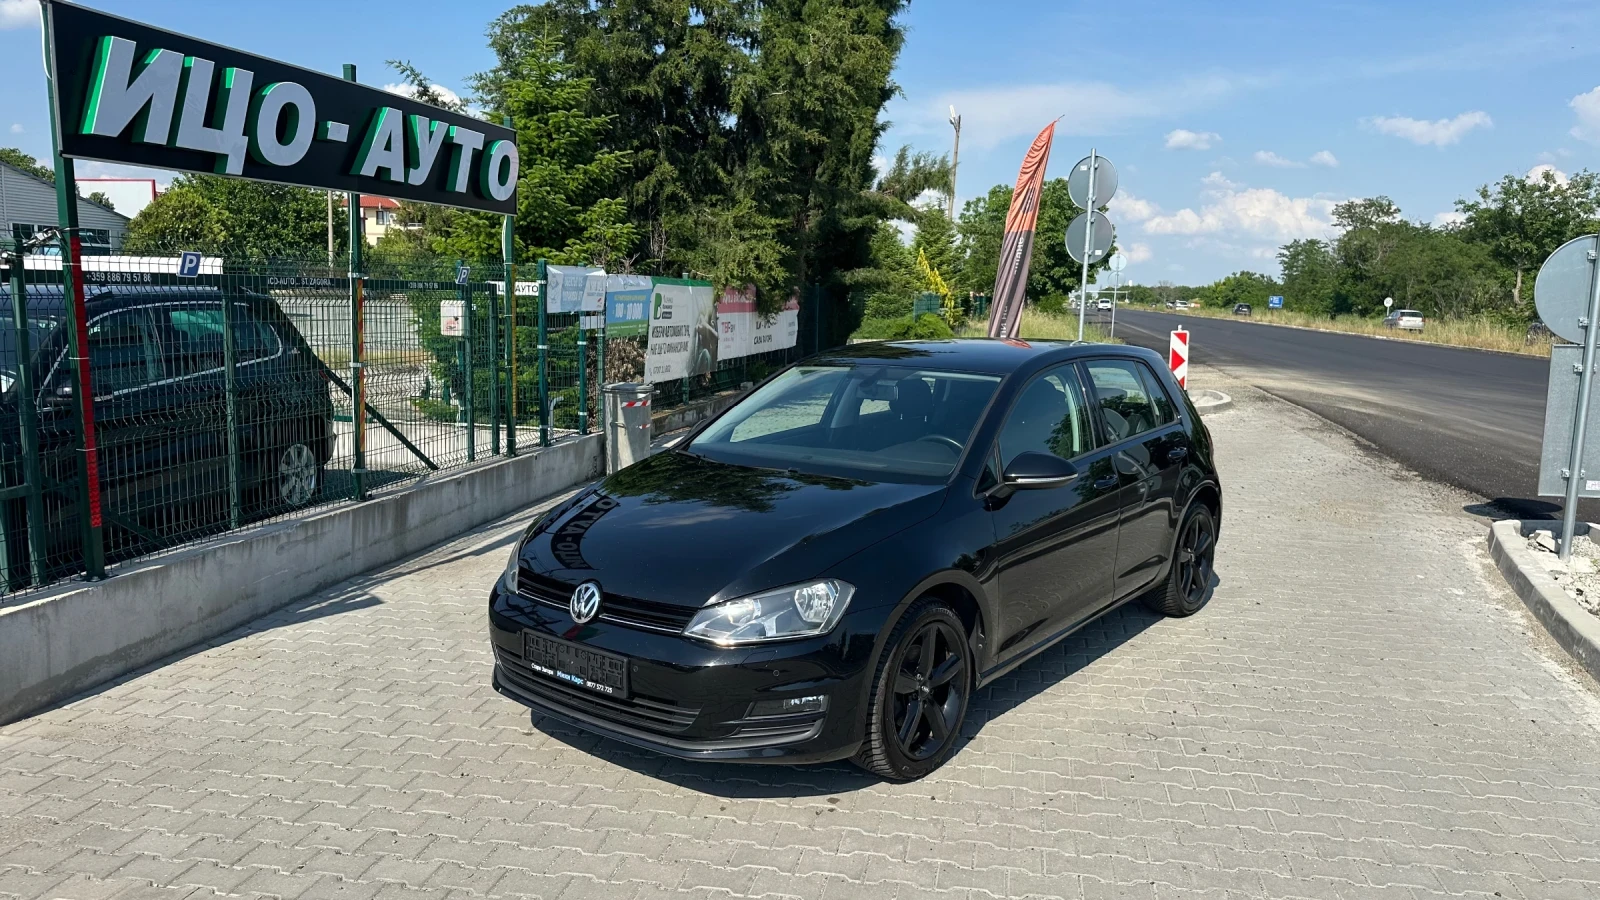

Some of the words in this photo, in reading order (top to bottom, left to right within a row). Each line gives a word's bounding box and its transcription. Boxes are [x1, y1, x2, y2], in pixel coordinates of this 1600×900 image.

[79, 35, 519, 201] ИЦО-АУТО
[183, 254, 197, 274] P
[86, 271, 105, 282] +359
[122, 273, 131, 282] 79
[133, 274, 141, 282] 57
